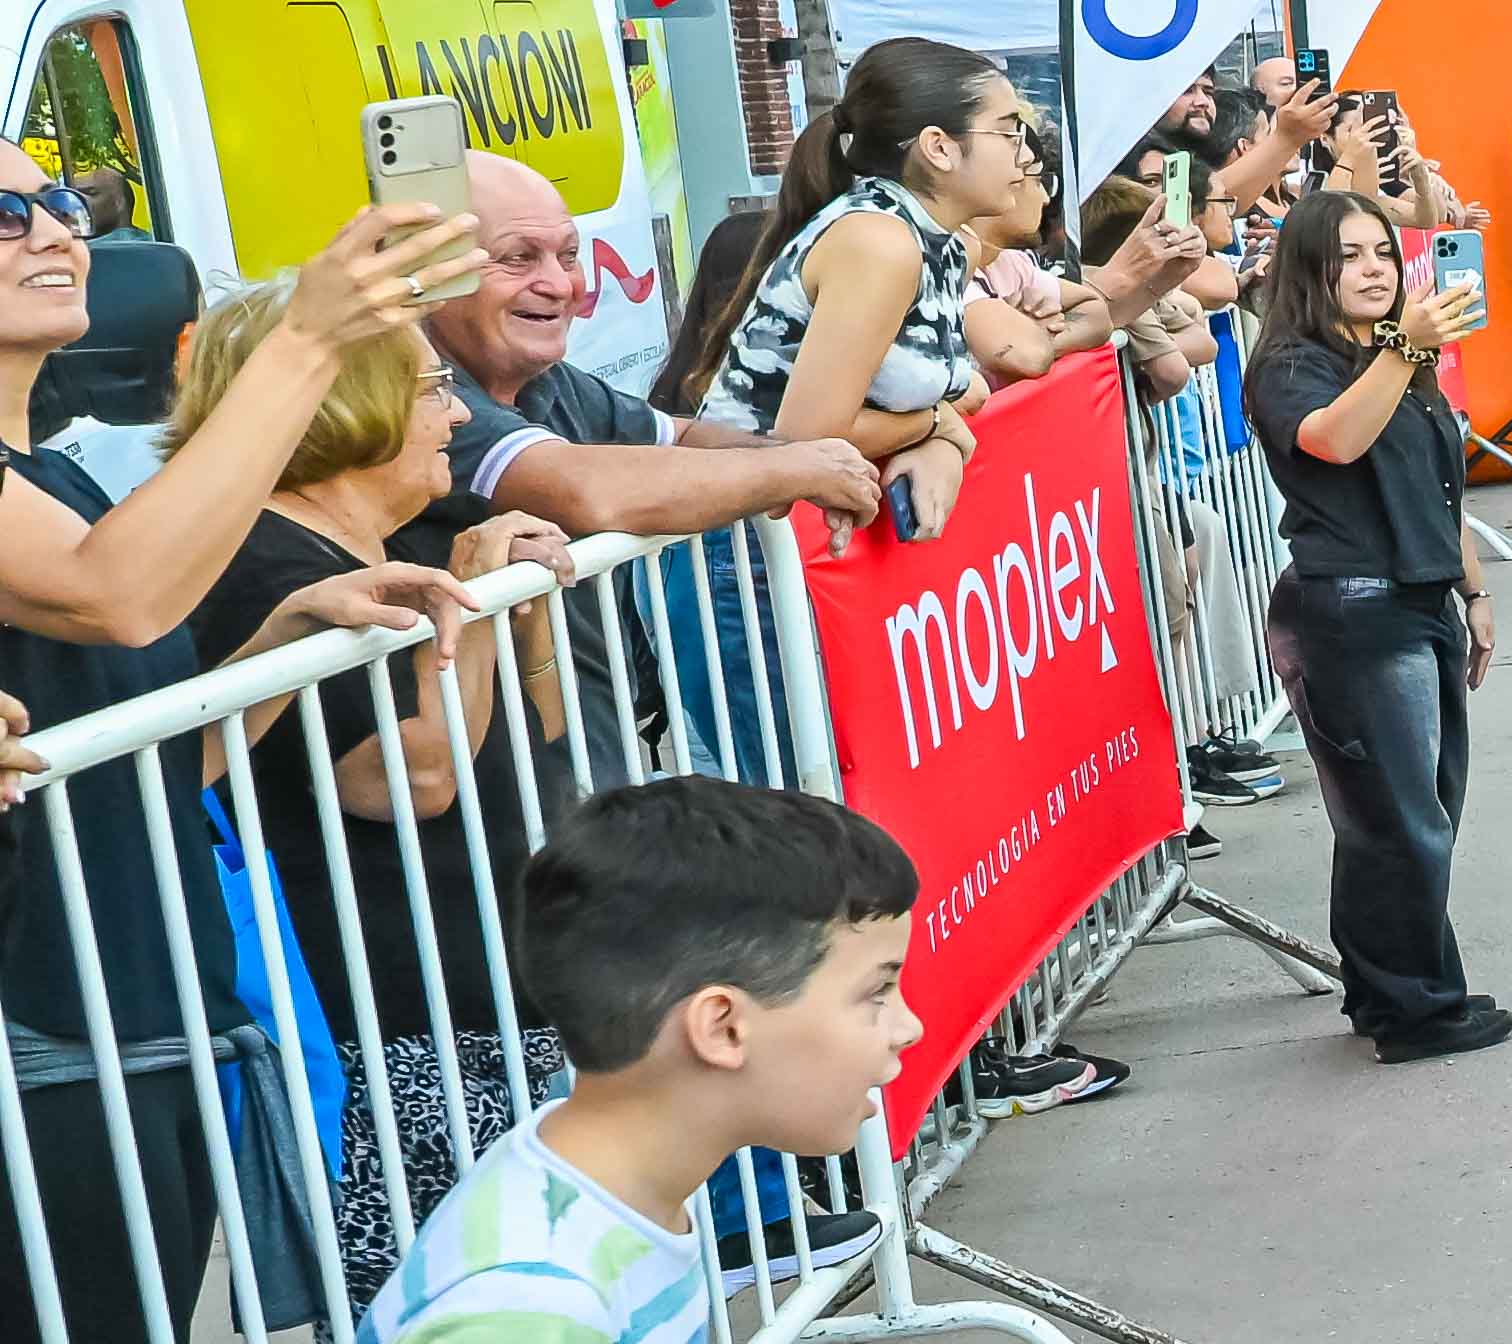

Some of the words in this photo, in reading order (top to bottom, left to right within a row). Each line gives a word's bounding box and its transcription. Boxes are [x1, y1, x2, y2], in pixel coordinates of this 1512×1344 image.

[886, 472, 1116, 770] moplex
[926, 814, 1041, 954] TECNOLOGIA
[1047, 787, 1066, 828] EN
[1071, 751, 1100, 804] TUS
[1105, 725, 1140, 771] PIES
